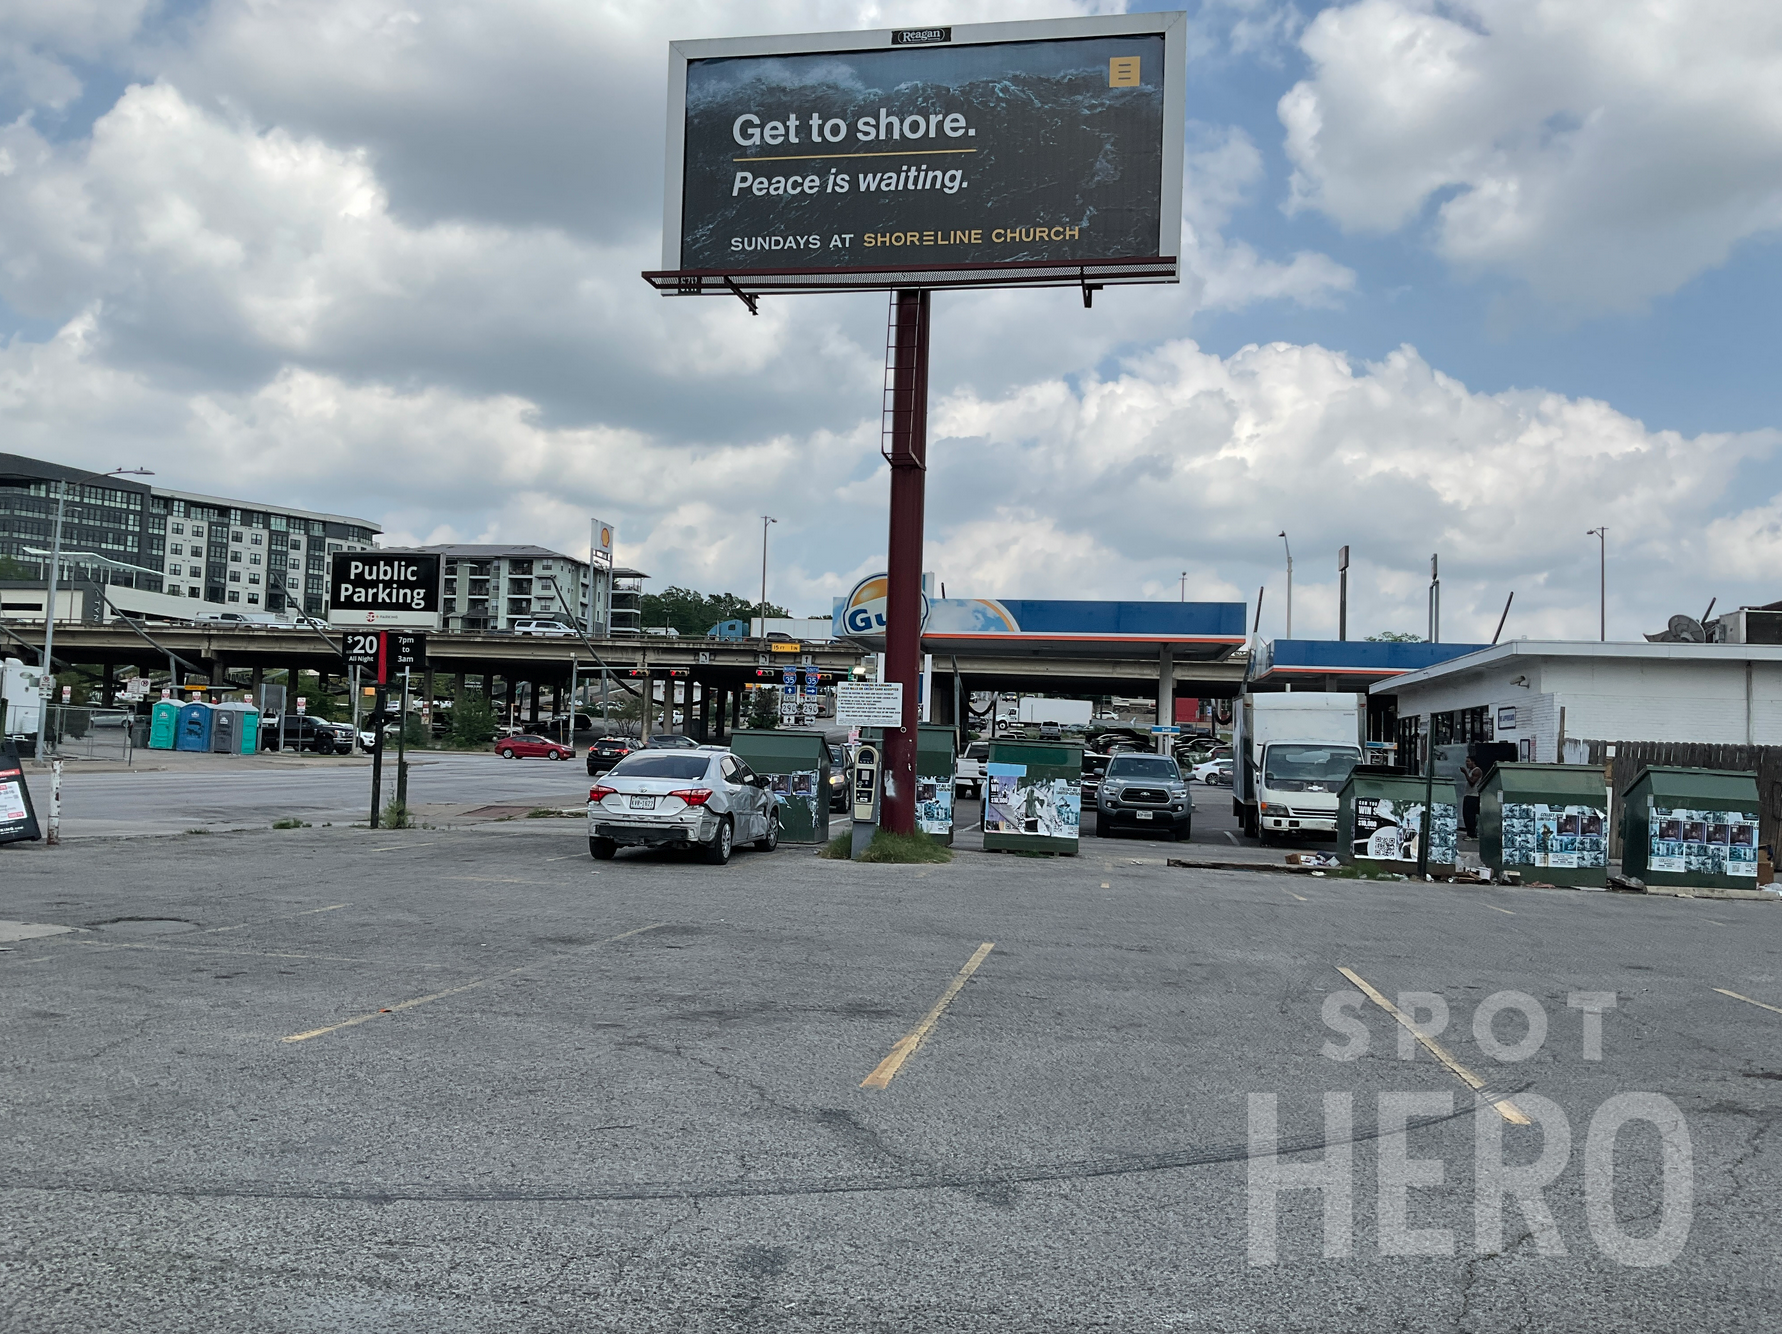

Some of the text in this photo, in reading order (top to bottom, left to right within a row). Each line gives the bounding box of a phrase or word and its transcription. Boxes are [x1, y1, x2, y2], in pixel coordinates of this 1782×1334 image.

[903, 30, 940, 42] Reagan
[732, 108, 976, 146] Get to shore.
[731, 165, 968, 197] Peace is waiting.
[730, 226, 1080, 251] SUNDAYS AT SHORELINE CHURCH
[350, 561, 418, 581] Public
[340, 583, 426, 609] Parking
[347, 635, 378, 654] $20
[398, 636, 415, 645] 7pm
[398, 655, 414, 663] 3am
[1358, 806, 1372, 816] WIN
